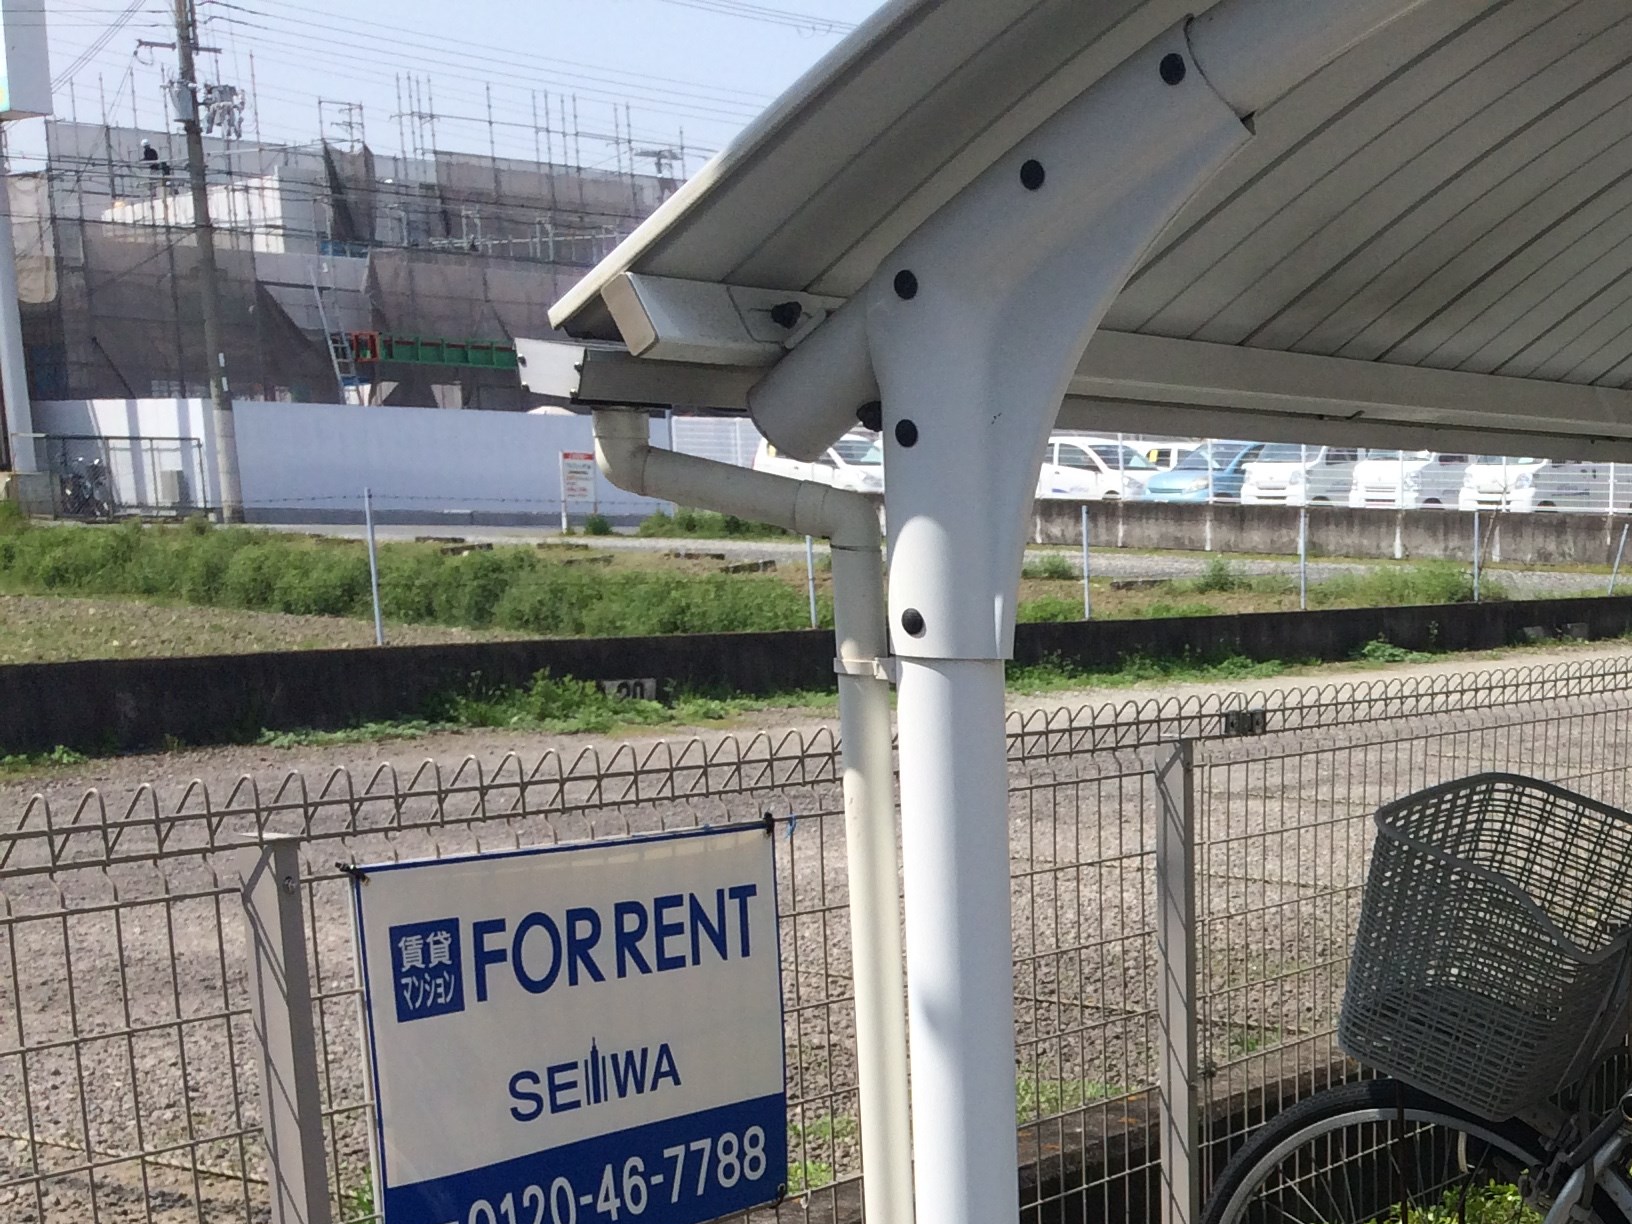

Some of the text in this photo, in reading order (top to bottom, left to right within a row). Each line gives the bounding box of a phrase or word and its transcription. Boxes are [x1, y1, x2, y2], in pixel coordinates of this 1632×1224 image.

[398, 930, 452, 972] 賃貸
[401, 970, 455, 1011] マンション
